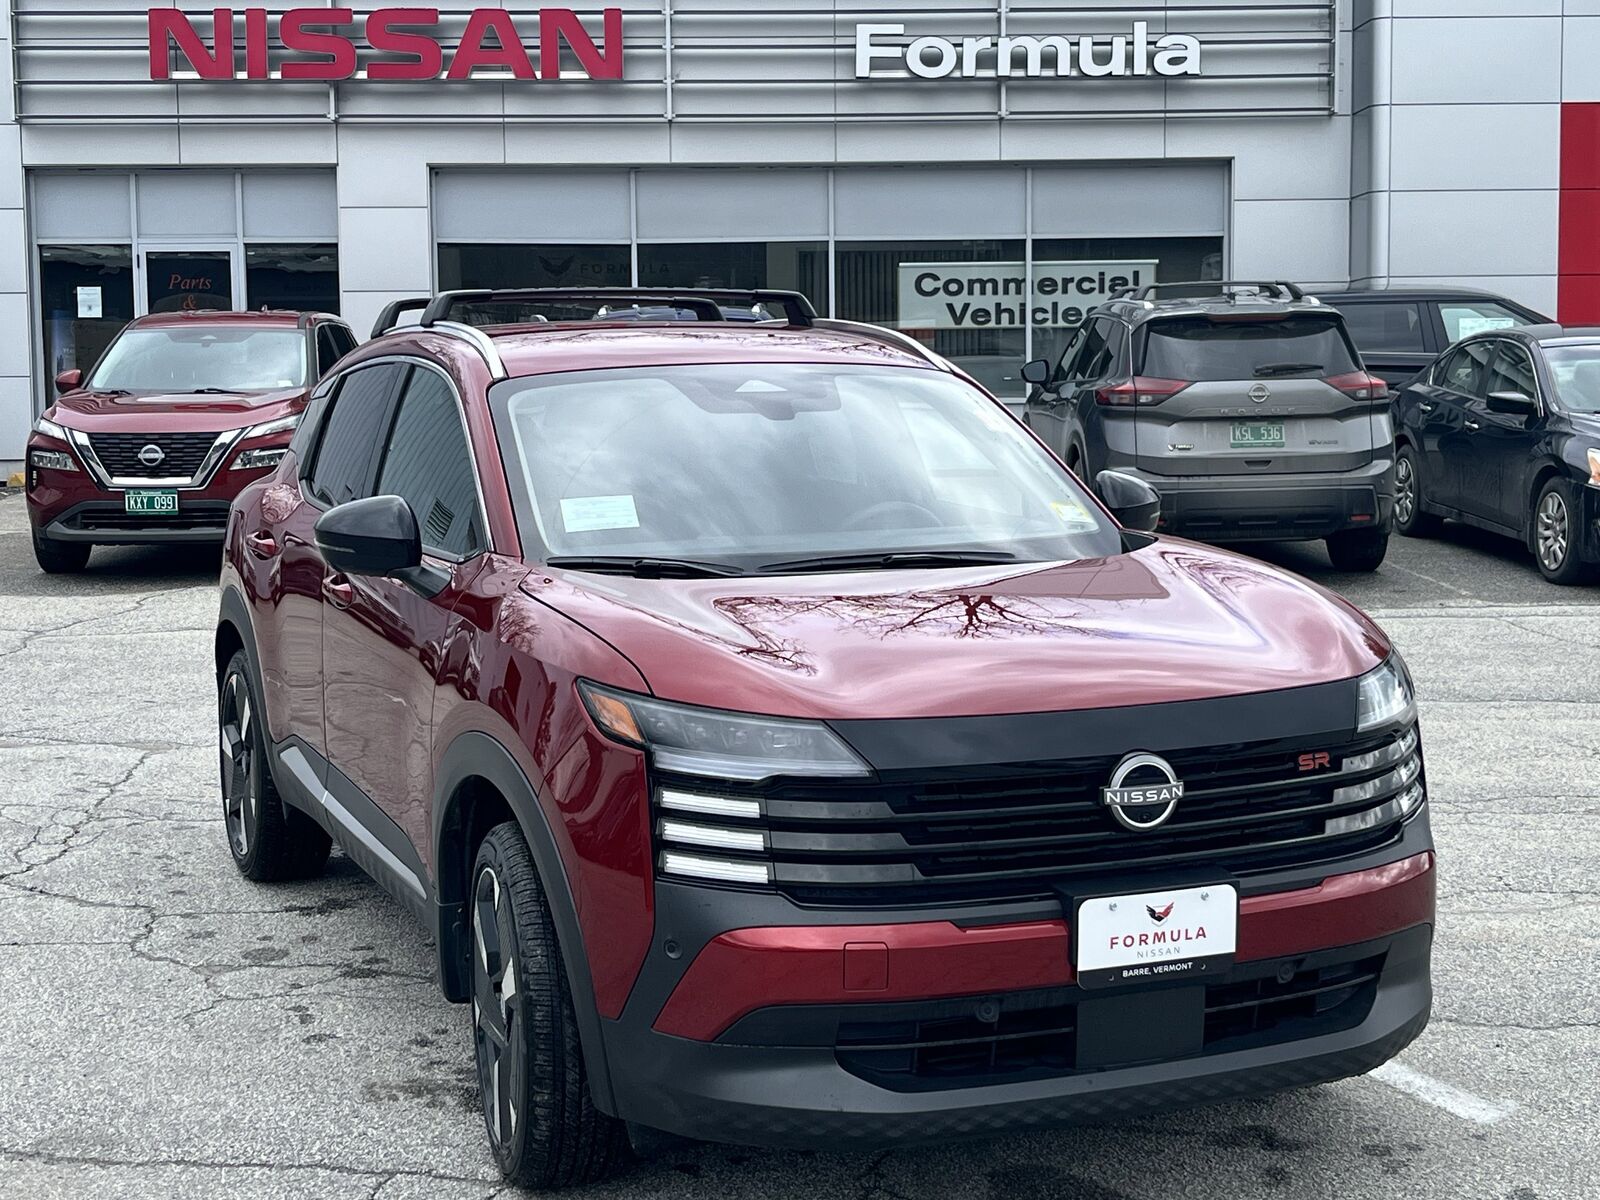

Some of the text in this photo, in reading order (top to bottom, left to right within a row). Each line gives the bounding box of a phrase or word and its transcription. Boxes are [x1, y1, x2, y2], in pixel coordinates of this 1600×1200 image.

[149, 7, 624, 82] NISSAN
[855, 20, 1203, 80] Formula
[168, 274, 212, 290] Parts
[914, 270, 1140, 297] Commercial
[183, 294, 196, 310] &
[1235, 426, 1281, 440] KSL 536
[129, 496, 173, 509] KXY 099
[1298, 751, 1331, 771] SR
[1106, 785, 1183, 803] NISSAN
[1109, 926, 1207, 950] FORMULA
[1136, 946, 1181, 959] NISSAN
[1122, 962, 1193, 978] BARRE, VERMONT
